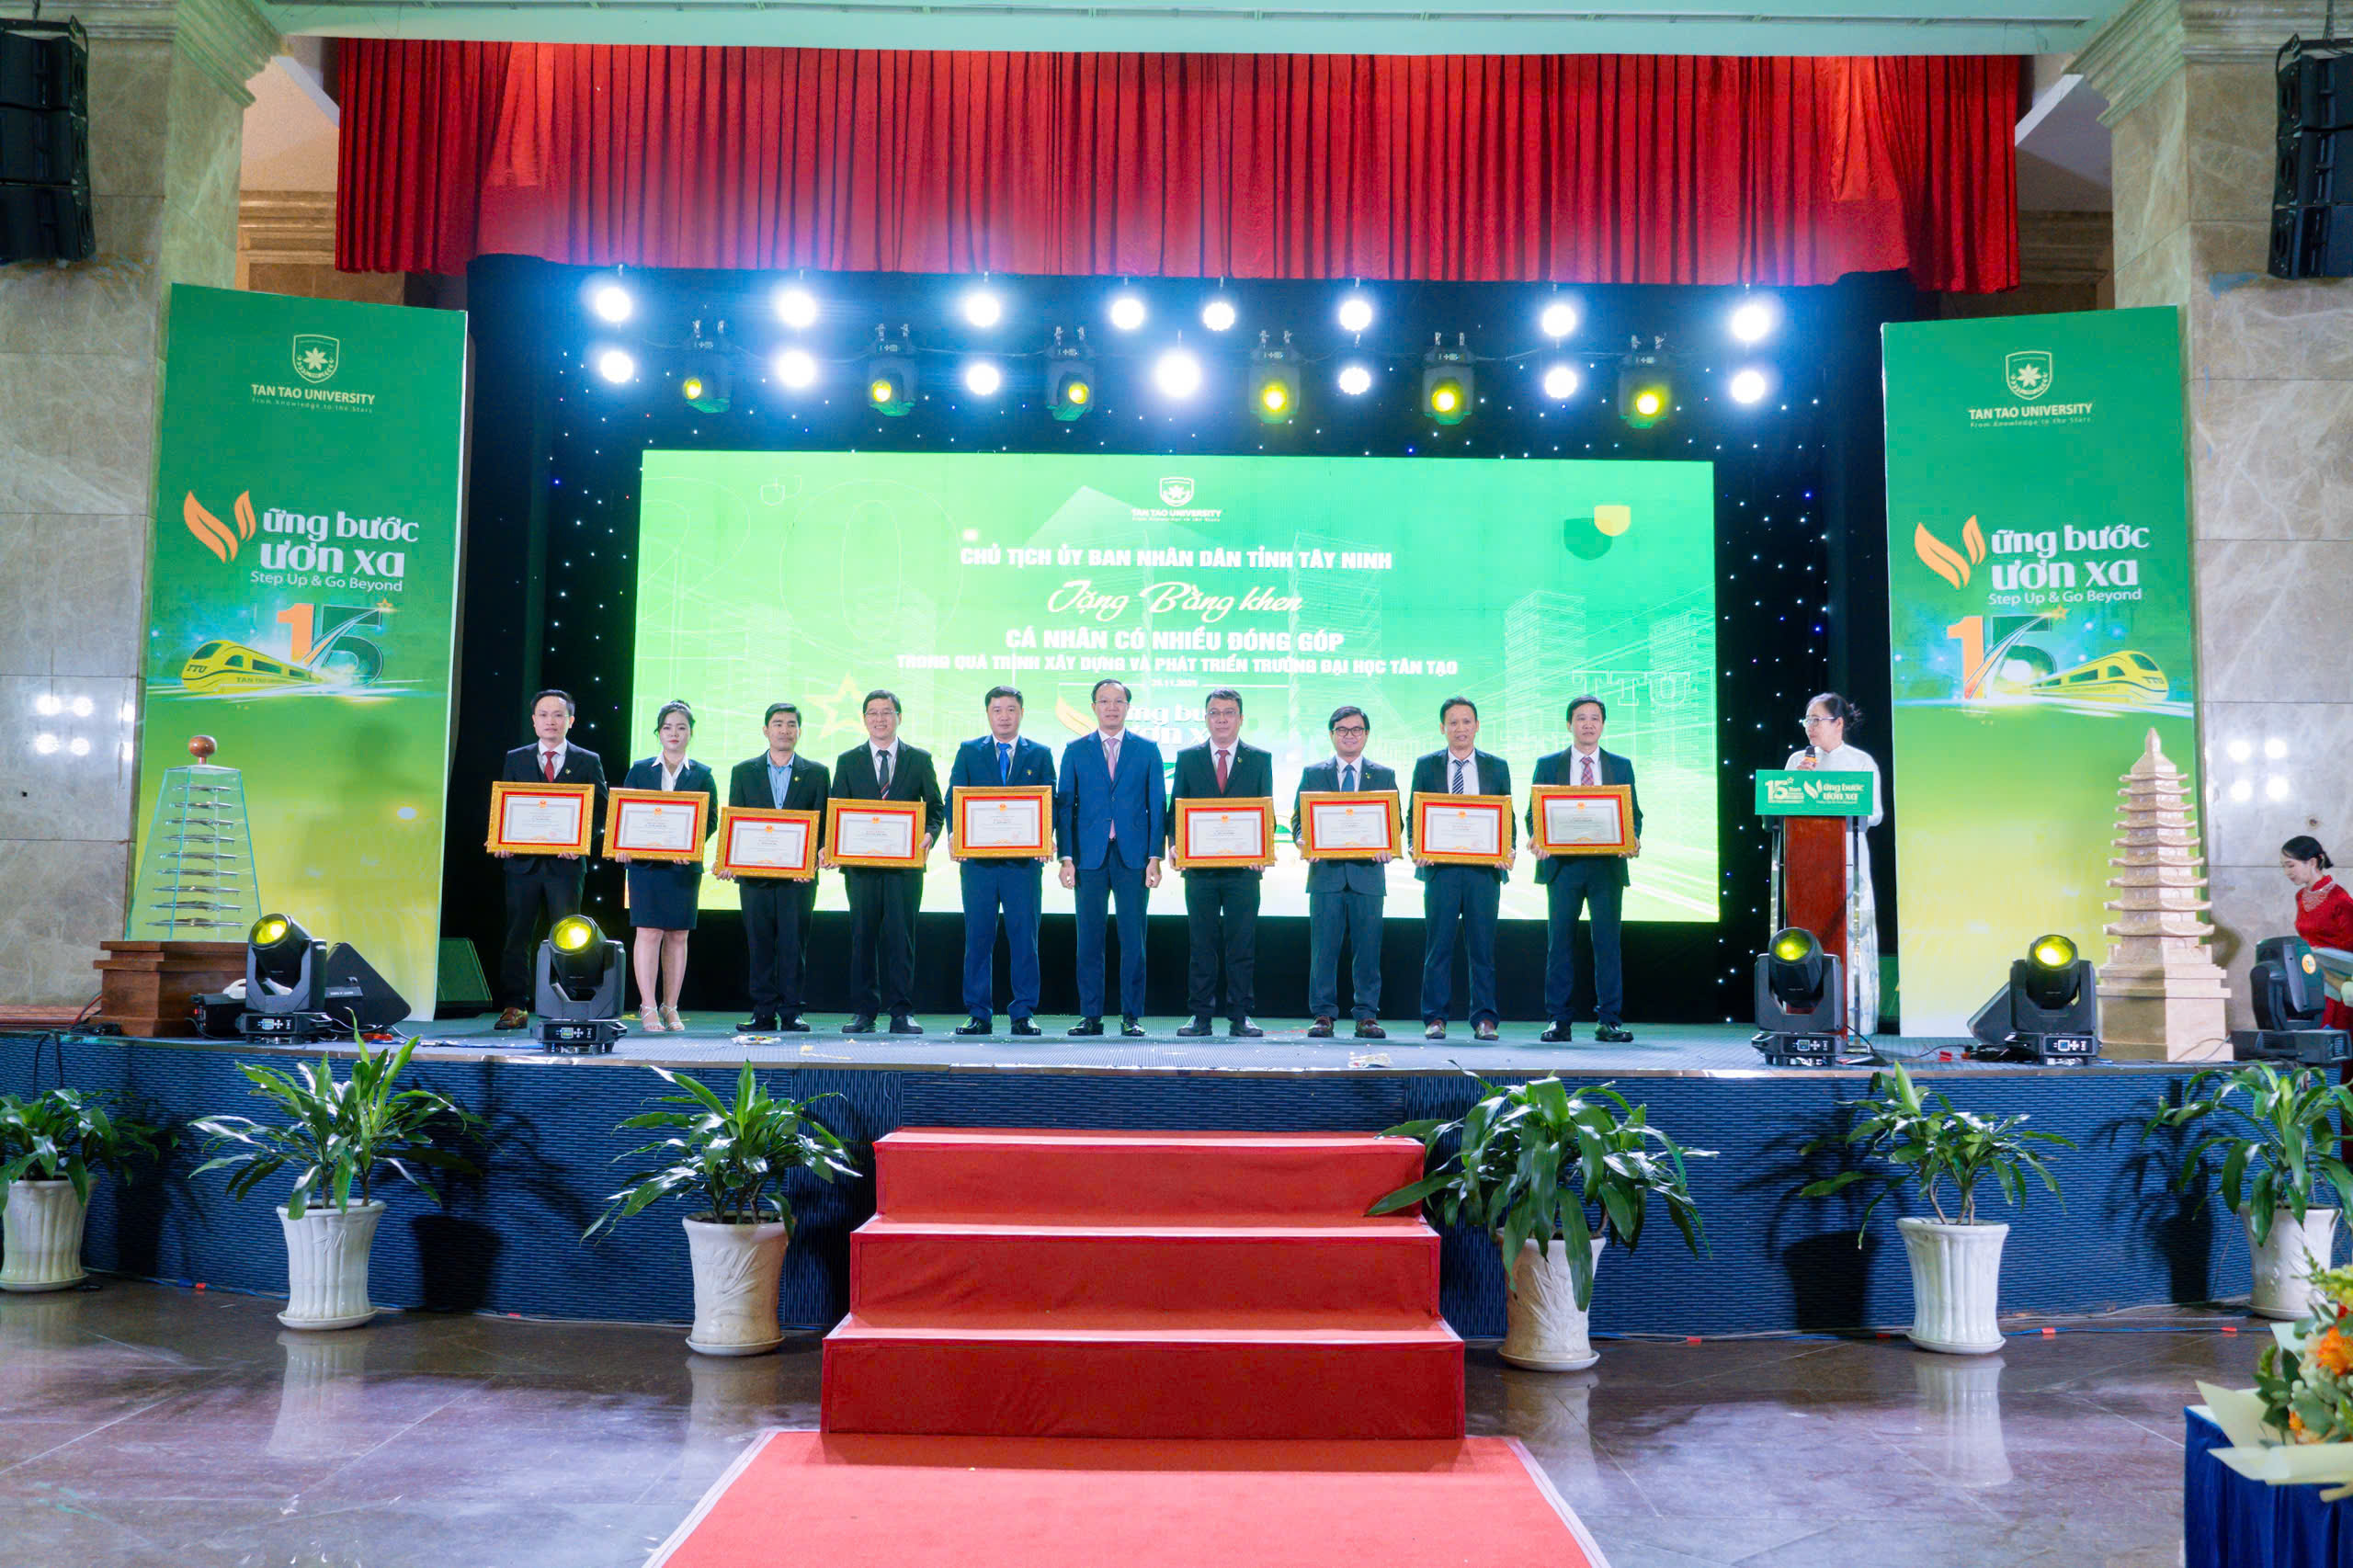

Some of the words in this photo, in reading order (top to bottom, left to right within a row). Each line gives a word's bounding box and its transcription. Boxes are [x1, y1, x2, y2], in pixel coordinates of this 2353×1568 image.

[251, 384, 276, 396] TAN
[278, 386, 301, 399] TAO
[304, 389, 376, 405] UNIVERSITY
[1969, 408, 1993, 419] TAN
[1995, 406, 2019, 418] TAO
[2021, 403, 2093, 417] UNIVERSITY
[336, 510, 420, 542] bước
[2063, 524, 2150, 551] bước
[353, 549, 405, 578] xa
[961, 544, 1001, 565] CHỦ
[1007, 548, 1051, 568] TỊCH
[1058, 544, 1083, 565] ỦY
[1088, 550, 1131, 566] BAN
[1137, 547, 1193, 567] NHÂN
[1199, 548, 1241, 567] DÂN
[1246, 545, 1293, 568] TỈNH
[1298, 549, 1336, 569] TÂY
[1341, 551, 1392, 569] NINH
[250, 571, 283, 586] Step
[287, 572, 308, 588] Up
[311, 574, 322, 586] &
[325, 575, 347, 588] Go
[349, 576, 403, 593] Beyond
[2085, 560, 2139, 587] xa
[1048, 579, 1130, 621] Tặng
[1139, 581, 1234, 623] Bằng
[1238, 586, 1302, 612] khen
[1988, 593, 2021, 606] Step
[2024, 592, 2045, 606] Up
[2048, 591, 2060, 603] &
[2063, 590, 2083, 602] Go
[2087, 588, 2143, 604] Beyond
[1006, 625, 1037, 648] CÁ
[1043, 626, 1108, 649] NHÂN
[1115, 627, 1145, 649] CÓ
[1227, 628, 1290, 652] ĐÓNG
[1298, 630, 1345, 652] GÓP
[187, 664, 208, 673] TTU
[896, 654, 950, 669] TRONG
[954, 653, 988, 671] QUÁ
[1044, 653, 1076, 670] XÂY
[1080, 655, 1126, 673] DỰNG
[1154, 655, 1198, 672] PHÁT
[1200, 653, 1248, 673] TRIỂN
[1252, 656, 1317, 674] TRƯỜNG
[1321, 659, 1348, 676] ĐẠI
[1353, 660, 1386, 676] HỌC
[1390, 658, 1423, 675] TÂN
[1427, 660, 1458, 676] TẠO
